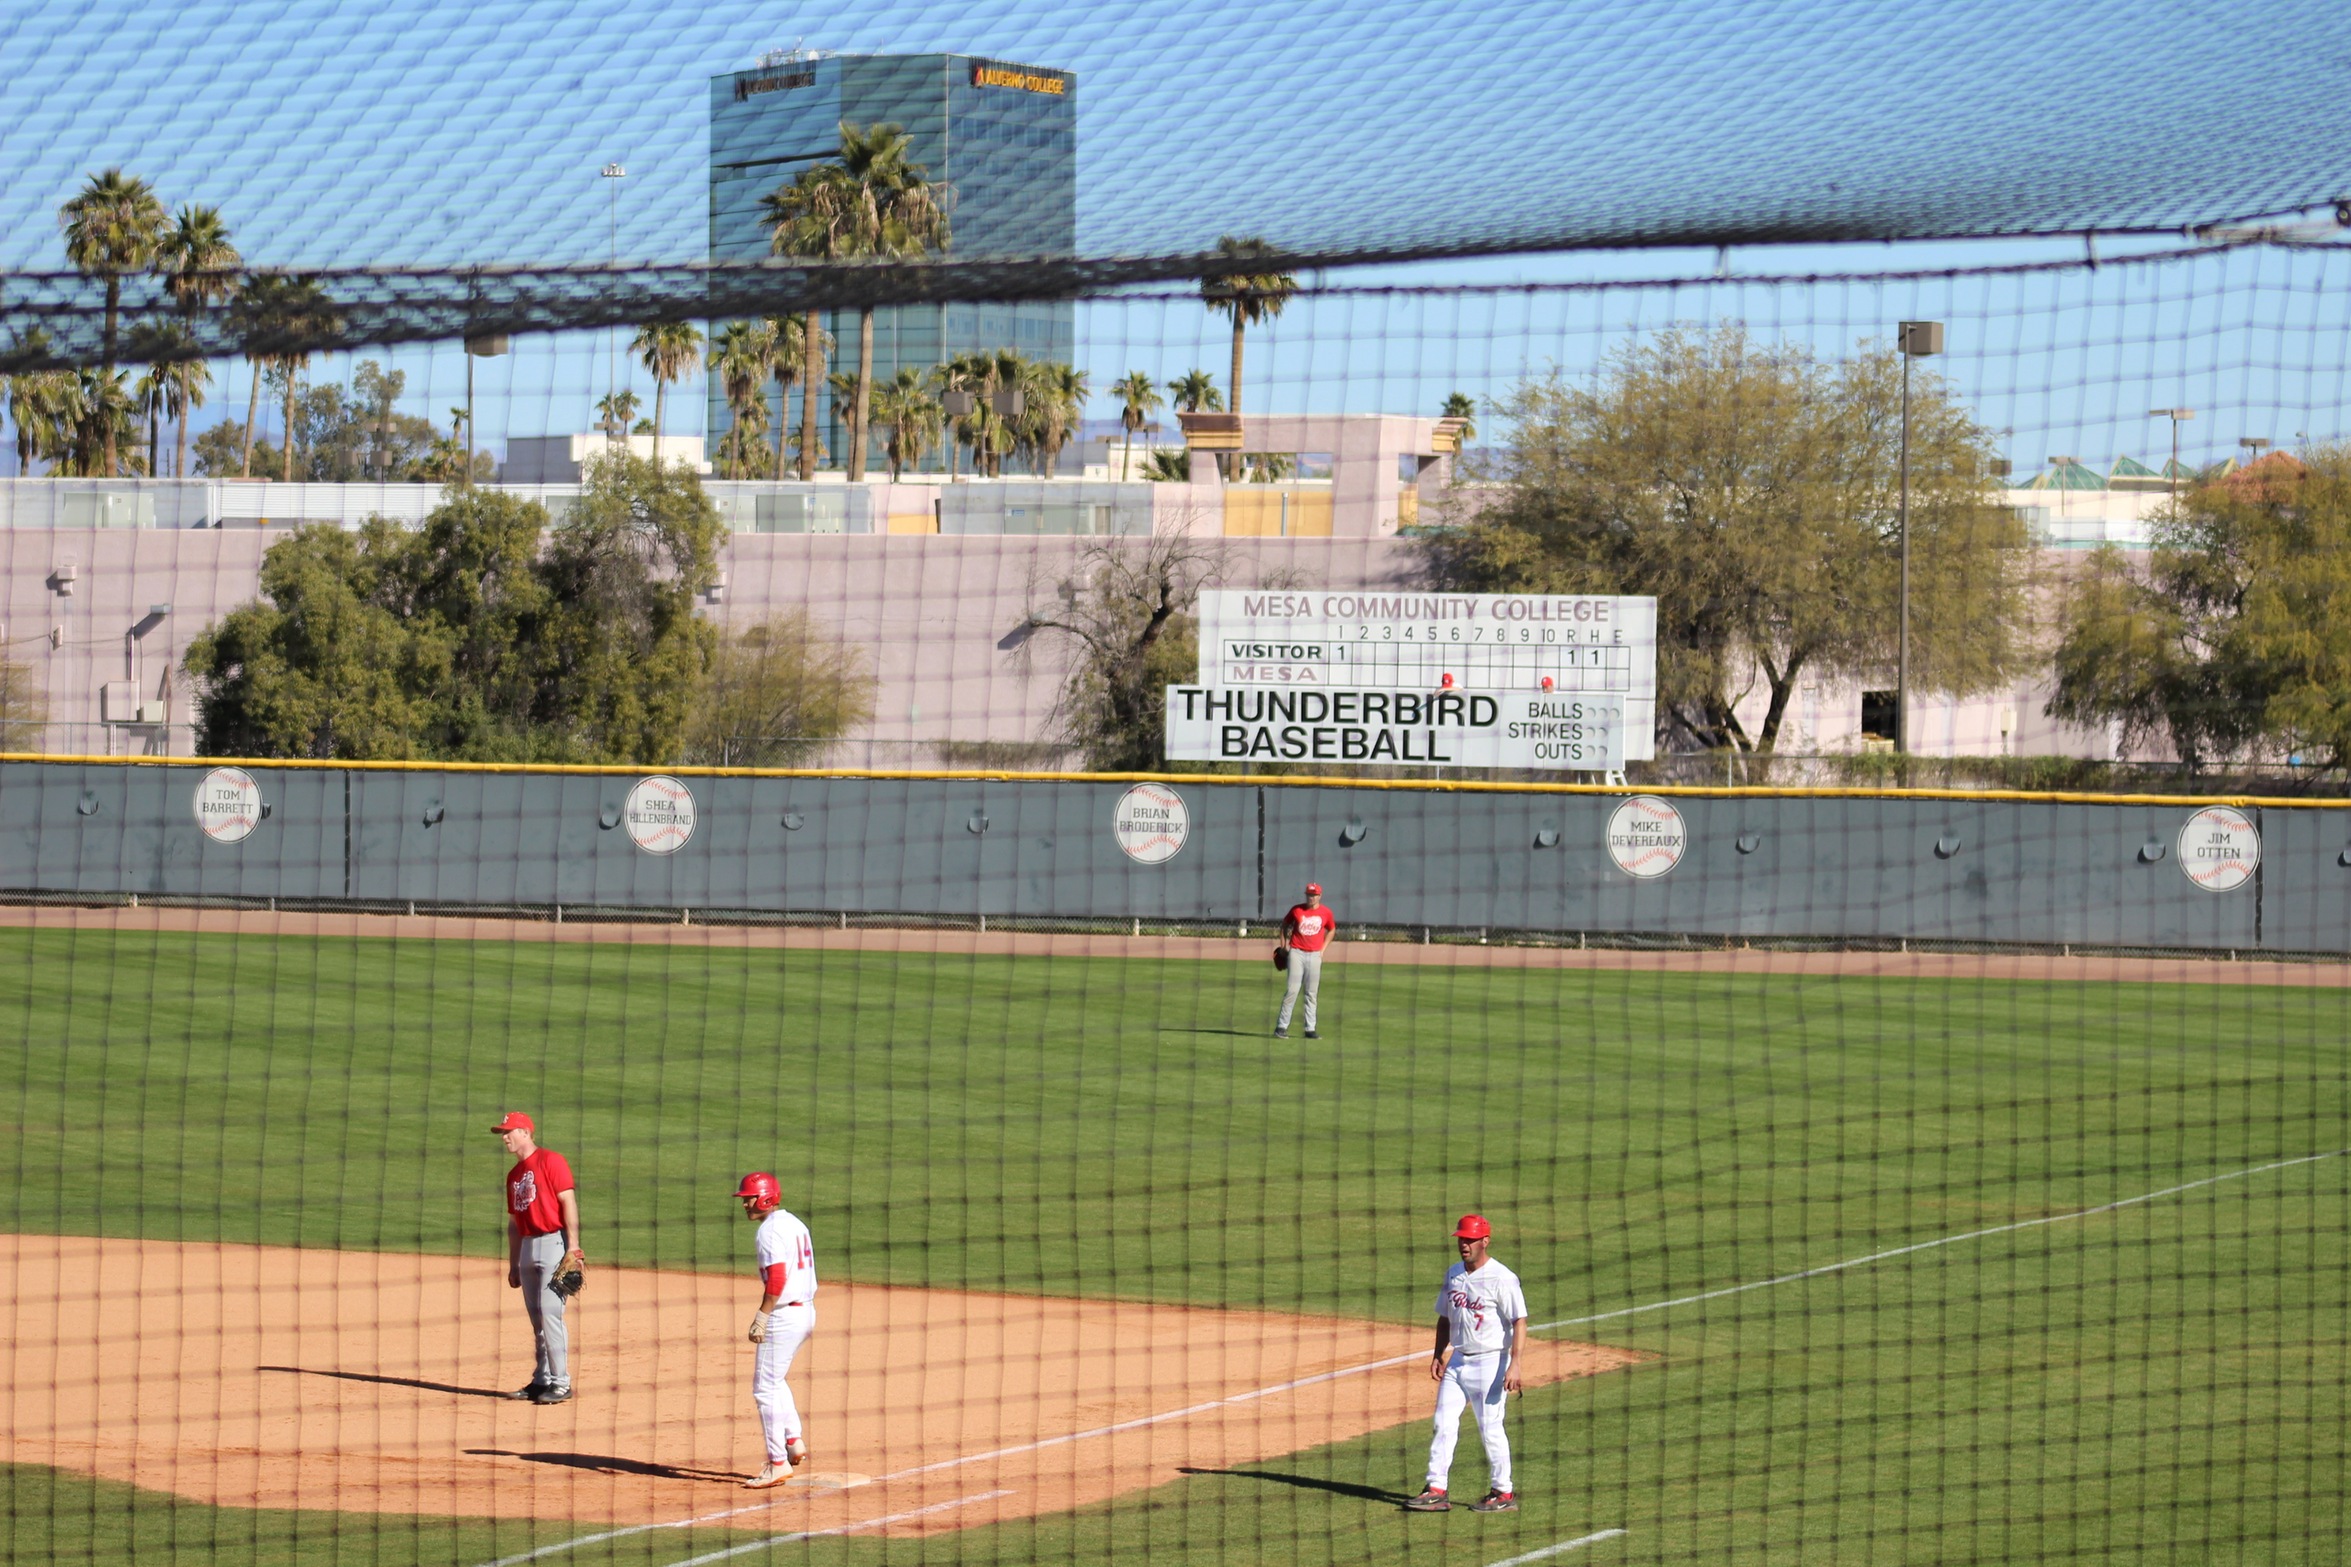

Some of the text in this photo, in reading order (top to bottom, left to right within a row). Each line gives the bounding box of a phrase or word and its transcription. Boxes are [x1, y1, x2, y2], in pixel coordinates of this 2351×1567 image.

[1026, 75, 1065, 95] COLLEGE
[1244, 596, 1609, 622] MESA COMMUNITY COLLEGE
[1360, 625, 1368, 640] 2
[1383, 626, 1391, 640] 3
[1405, 626, 1413, 641] 4
[1428, 626, 1437, 641] 5
[1451, 627, 1460, 641] 6
[1474, 627, 1483, 641] 7
[1497, 628, 1505, 642] 8
[1521, 628, 1530, 642] 9
[1542, 629, 1556, 643] 10
[1568, 629, 1576, 643] R
[1591, 630, 1599, 644] H
[1614, 630, 1623, 644] E
[1231, 644, 1598, 665] VISITOR 1 1 1
[1233, 666, 1318, 681] MESA
[1177, 689, 1499, 727] THUNDERBIRD
[1528, 703, 1583, 719] BALLS
[1508, 722, 1583, 740] STRIKES
[1222, 725, 1451, 762] BASEBALL
[1535, 743, 1583, 760] OUTS
[216, 789, 240, 800] TOM
[202, 802, 253, 814] BARRETT
[645, 800, 676, 811] SHEA
[1133, 807, 1170, 819] BRIAN
[629, 812, 692, 825] HILLENBRAND
[1119, 821, 1183, 833] BRODERICK
[1630, 821, 1662, 832] MIKE
[1611, 835, 1681, 847] DEVEREAUX
[2207, 833, 2231, 844] JIM
[2197, 847, 2240, 859] OTTEN
[796, 1233, 813, 1270] 14
[1474, 1313, 1484, 1331] 7
